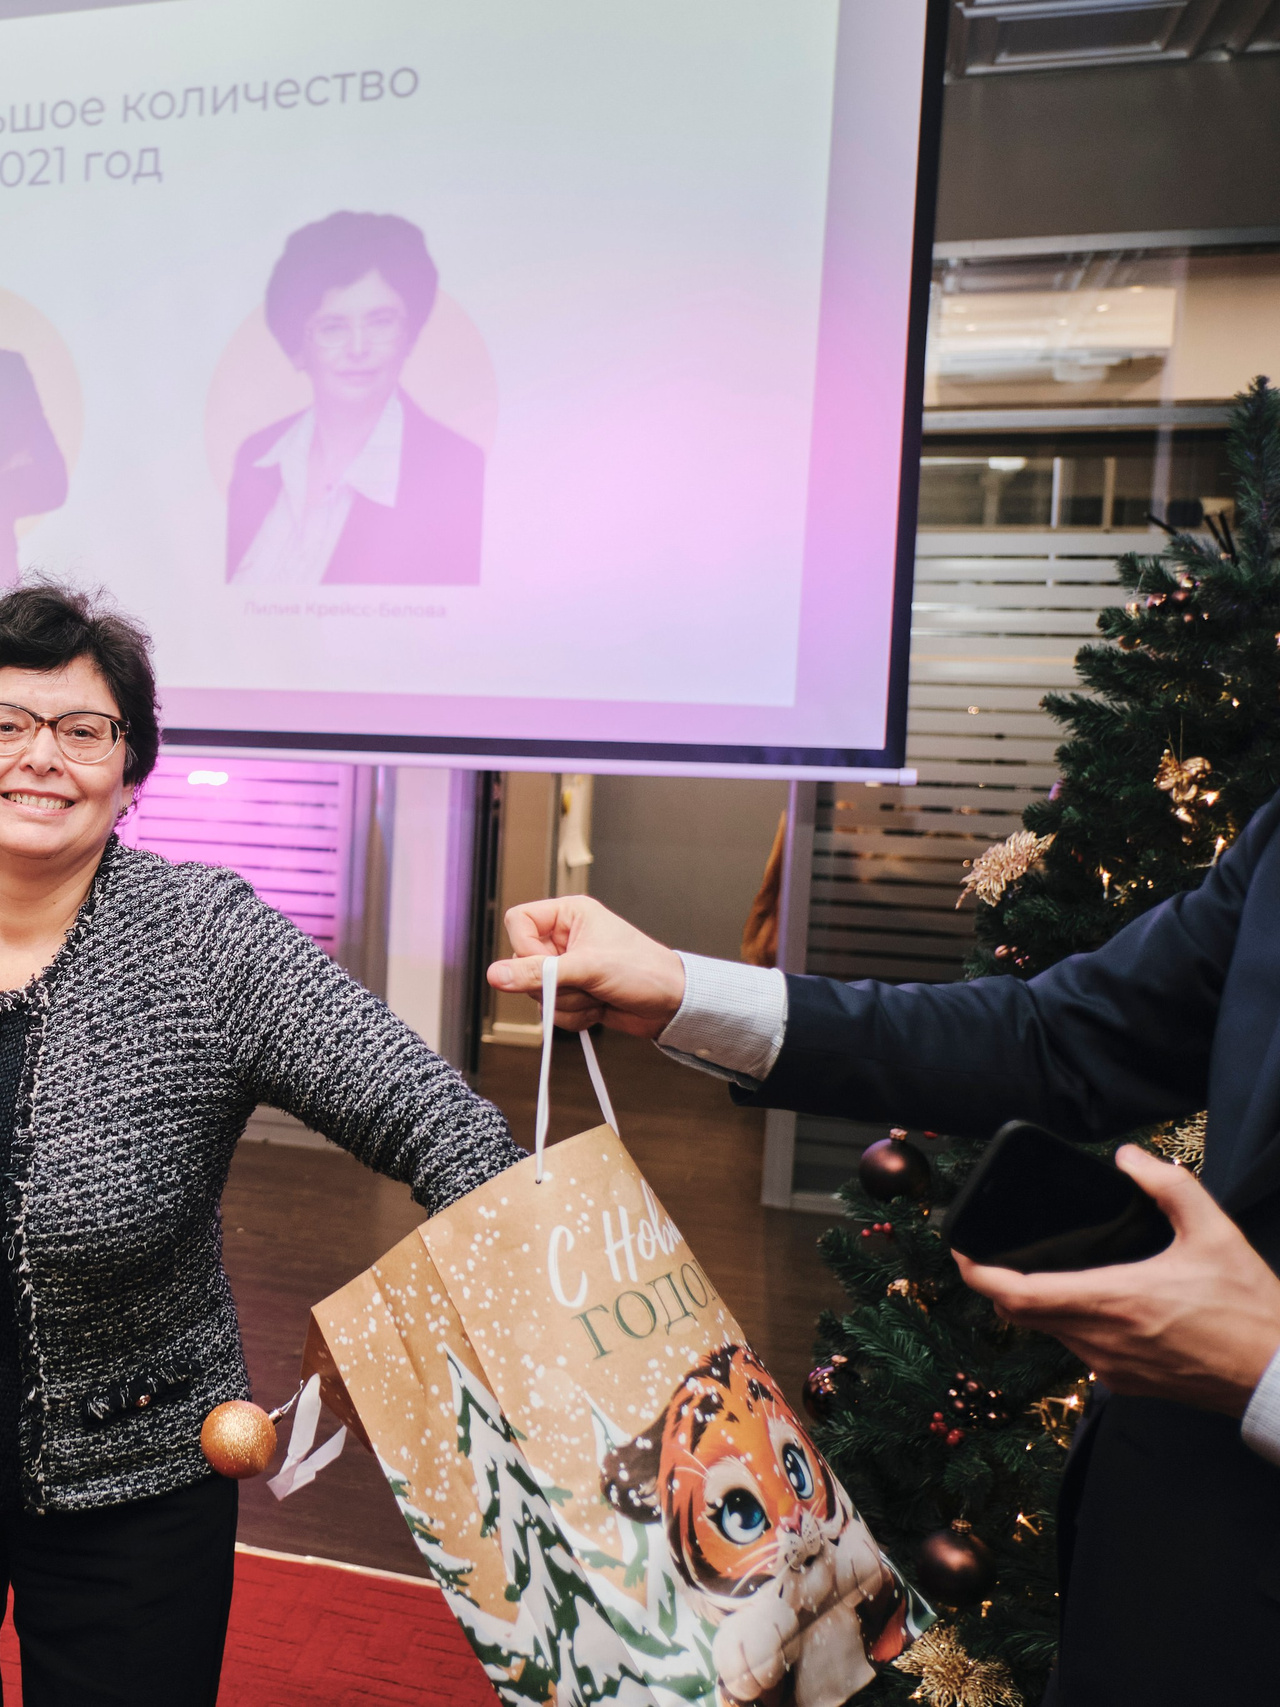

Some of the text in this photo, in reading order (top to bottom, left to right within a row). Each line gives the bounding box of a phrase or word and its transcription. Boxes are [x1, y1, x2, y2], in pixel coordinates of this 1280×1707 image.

[122, 67, 419, 123] количество
[84, 147, 163, 185] год
[548, 1225, 588, 1308] С
[571, 1259, 717, 1360] ГОДО
